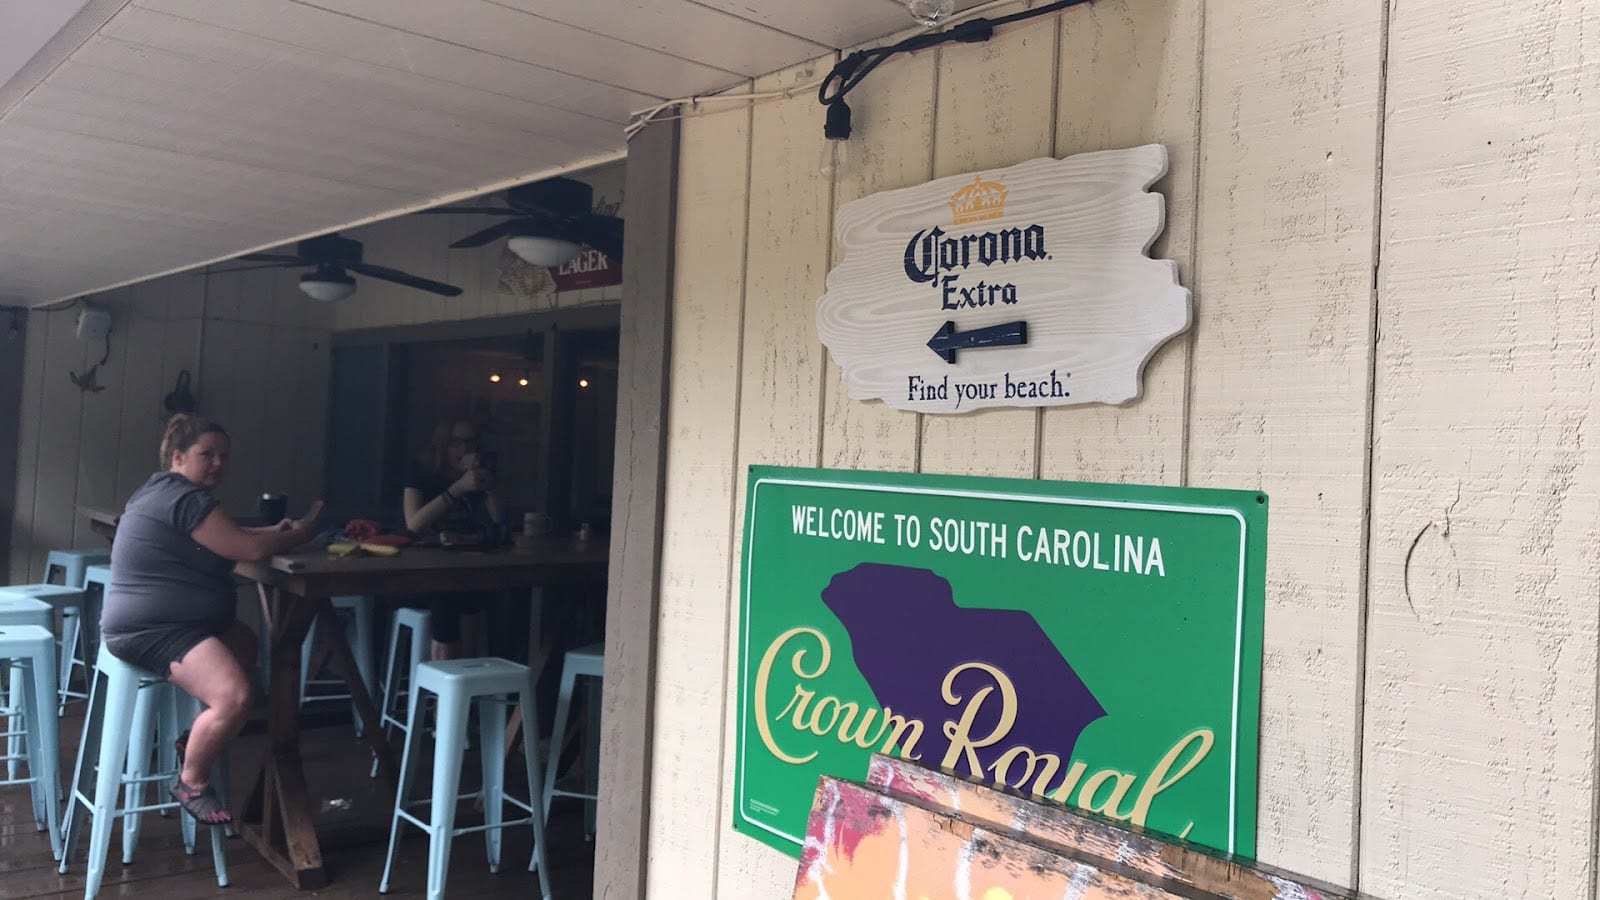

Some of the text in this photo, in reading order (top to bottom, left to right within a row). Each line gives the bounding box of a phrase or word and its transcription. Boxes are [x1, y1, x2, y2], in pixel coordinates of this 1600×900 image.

[940, 274, 1018, 310] Extra
[907, 375, 949, 400] Find
[954, 383, 998, 409] your
[791, 504, 1165, 577] WELCOME TO SOUTH CAROLINA
[754, 627, 925, 765] Crown
